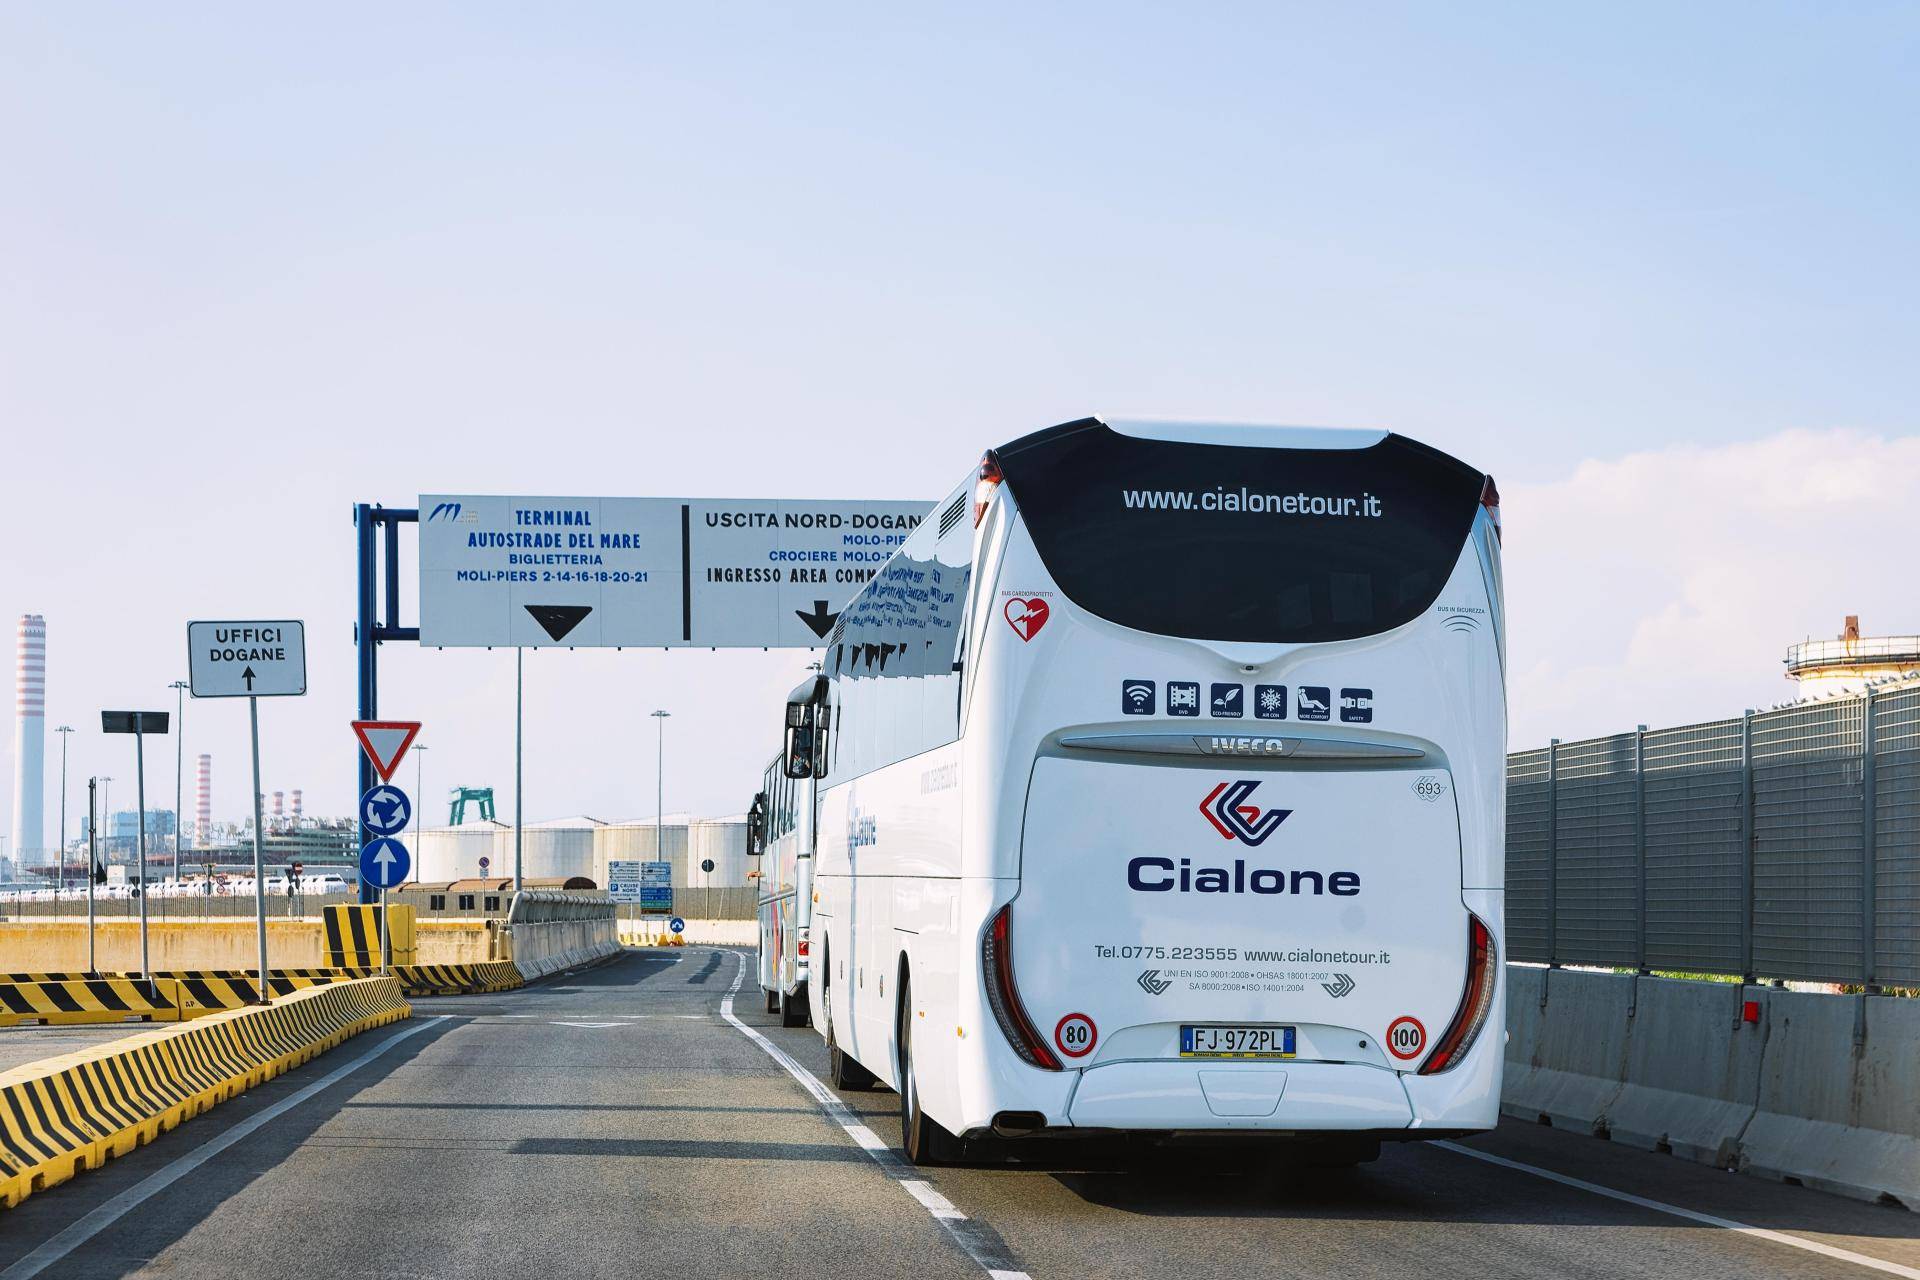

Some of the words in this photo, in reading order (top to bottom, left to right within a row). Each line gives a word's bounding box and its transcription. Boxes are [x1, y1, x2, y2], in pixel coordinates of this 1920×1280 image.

[1123, 486, 1382, 517] www.cialonetour.it
[516, 510, 591, 526] TERMINAL
[705, 513, 779, 528] USCITA
[785, 513, 922, 529] NORD-DOGAN
[468, 532, 562, 548] AUTOSTRADE
[568, 533, 595, 548] DEL
[600, 533, 641, 549] MARE
[843, 534, 908, 546] MOLO-PIE
[509, 554, 603, 565] BIGLIETTERIA
[769, 551, 837, 562] CROCIERE
[843, 551, 893, 562] MOLO-P
[457, 570, 538, 582] MOLI-PIERS
[543, 571, 648, 583] 2-14-16-18-20-21
[707, 567, 781, 583] INGRESSO
[790, 568, 827, 583] AREA
[836, 568, 876, 583] COMM
[216, 628, 281, 643] UFFICI
[210, 648, 286, 662] DOGANE
[1211, 737, 1283, 752] IVECO
[1417, 782, 1441, 795] 693
[1127, 857, 1361, 896] Cialone
[1095, 945, 1237, 961] Tel.0775.223555
[1244, 949, 1391, 964] www.cialonetour.it
[1164, 970, 1179, 978] UNI
[1181, 970, 1192, 978] EN
[1194, 970, 1209, 978] ISO
[1256, 971, 1285, 979] OHSAS
[1189, 982, 1200, 990] SA
[1066, 1025, 1087, 1043] 80
[1393, 1028, 1419, 1047] 100
